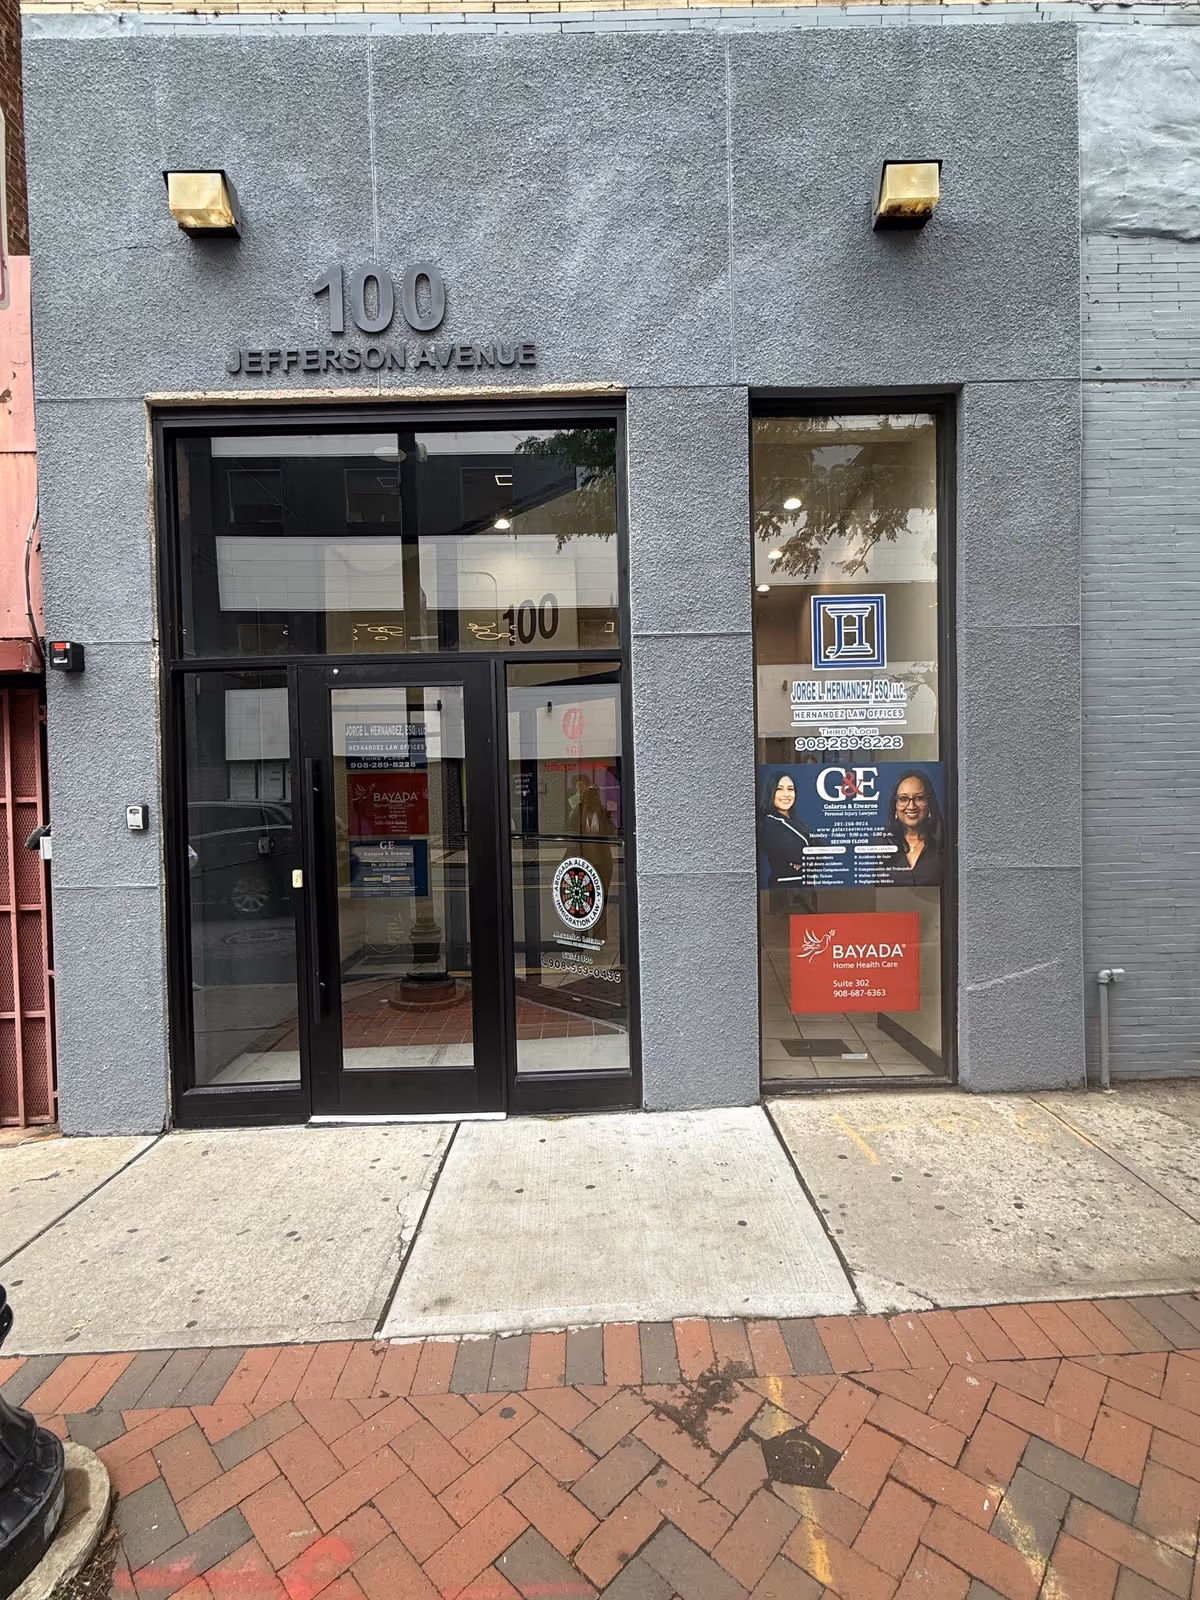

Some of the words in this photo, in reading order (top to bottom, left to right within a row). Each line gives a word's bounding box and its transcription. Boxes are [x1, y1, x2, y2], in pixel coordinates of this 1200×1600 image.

[313, 263, 446, 333] 100
[228, 347, 405, 373] JEFFERSON
[415, 340, 537, 368] AVENUE
[502, 592, 559, 647] 100
[791, 681, 816, 702] JORGE
[817, 681, 825, 701] L.
[826, 680, 873, 703] HERNANDEZ,
[874, 680, 891, 702] ESQ.
[891, 683, 906, 699] LLC.
[794, 710, 845, 719] HERNANDEZ
[847, 709, 865, 719] LAW
[867, 708, 903, 718] OFFICES
[346, 725, 363, 736] JORGE
[364, 725, 369, 736] L.
[795, 736, 903, 750] 908-289-8228
[350, 761, 417, 769] 908-289-8228
[543, 762, 577, 773] Jefferson
[816, 766, 880, 802] G&E
[374, 791, 418, 802] BAYADA
[554, 860, 573, 892] ABOGADA
[574, 859, 601, 897] ALEXANDRA
[555, 899, 591, 927] IMMIGRATION
[590, 903, 600, 920] LAW
[832, 943, 904, 959] BAYADA
[548, 958, 621, 983] 908-569-0436
[833, 980, 853, 988] Suite
[855, 979, 870, 987] 302
[833, 989, 887, 998] 908-687-6363
